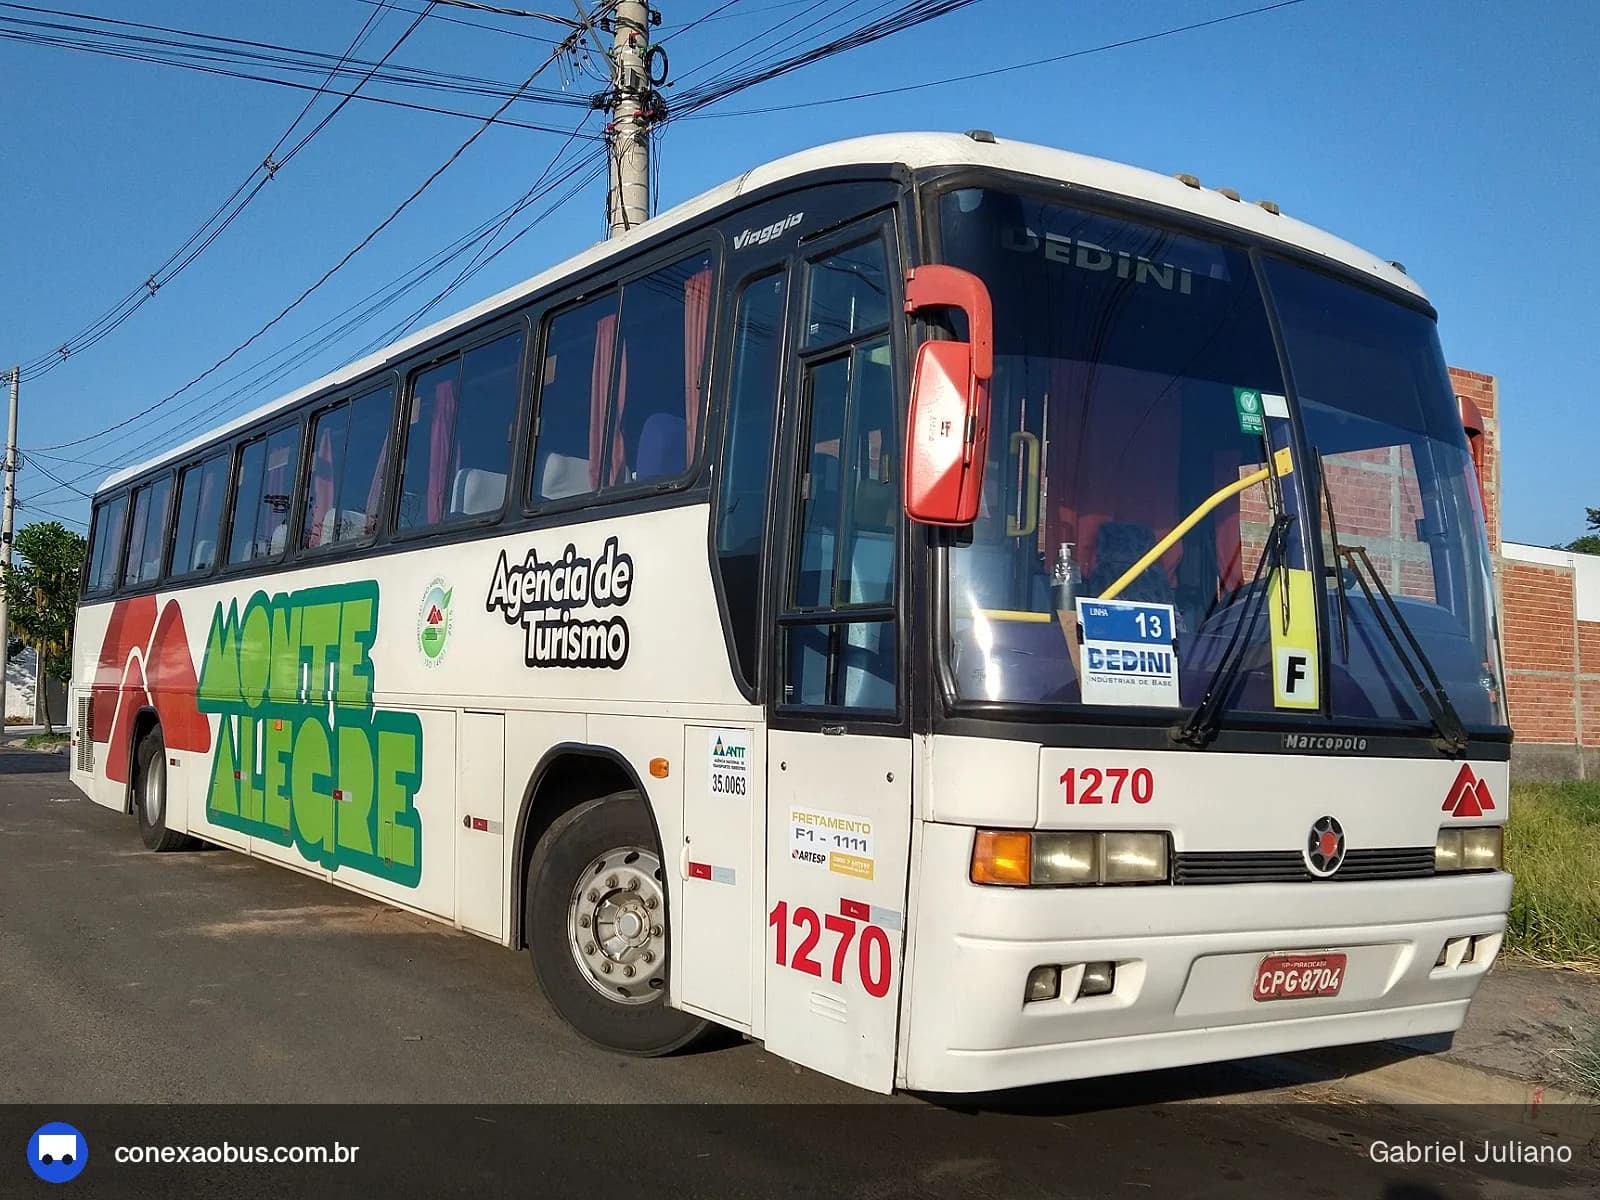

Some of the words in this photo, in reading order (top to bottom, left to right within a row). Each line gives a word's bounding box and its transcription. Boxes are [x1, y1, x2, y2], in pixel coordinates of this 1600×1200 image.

[733, 212, 804, 250] Viaggio
[1002, 227, 1192, 295] DEDINI
[487, 549, 590, 621] Agência
[592, 540, 632, 604] de
[522, 609, 627, 665] Turismo
[1135, 612, 1162, 638] 13
[198, 585, 377, 711] MONTE
[1087, 647, 1172, 674] DEDINI
[1286, 656, 1307, 693] F
[725, 745, 747, 759] ANTT
[1285, 734, 1368, 751] Marcopolo
[206, 711, 421, 878] ALEGRE
[712, 773, 746, 796] 35.0063
[1060, 767, 1154, 805] 1270
[792, 811, 871, 834] FRETAMENTO
[798, 850, 826, 864] ARTESP
[833, 834, 867, 852] 1111
[769, 900, 892, 998] 1270
